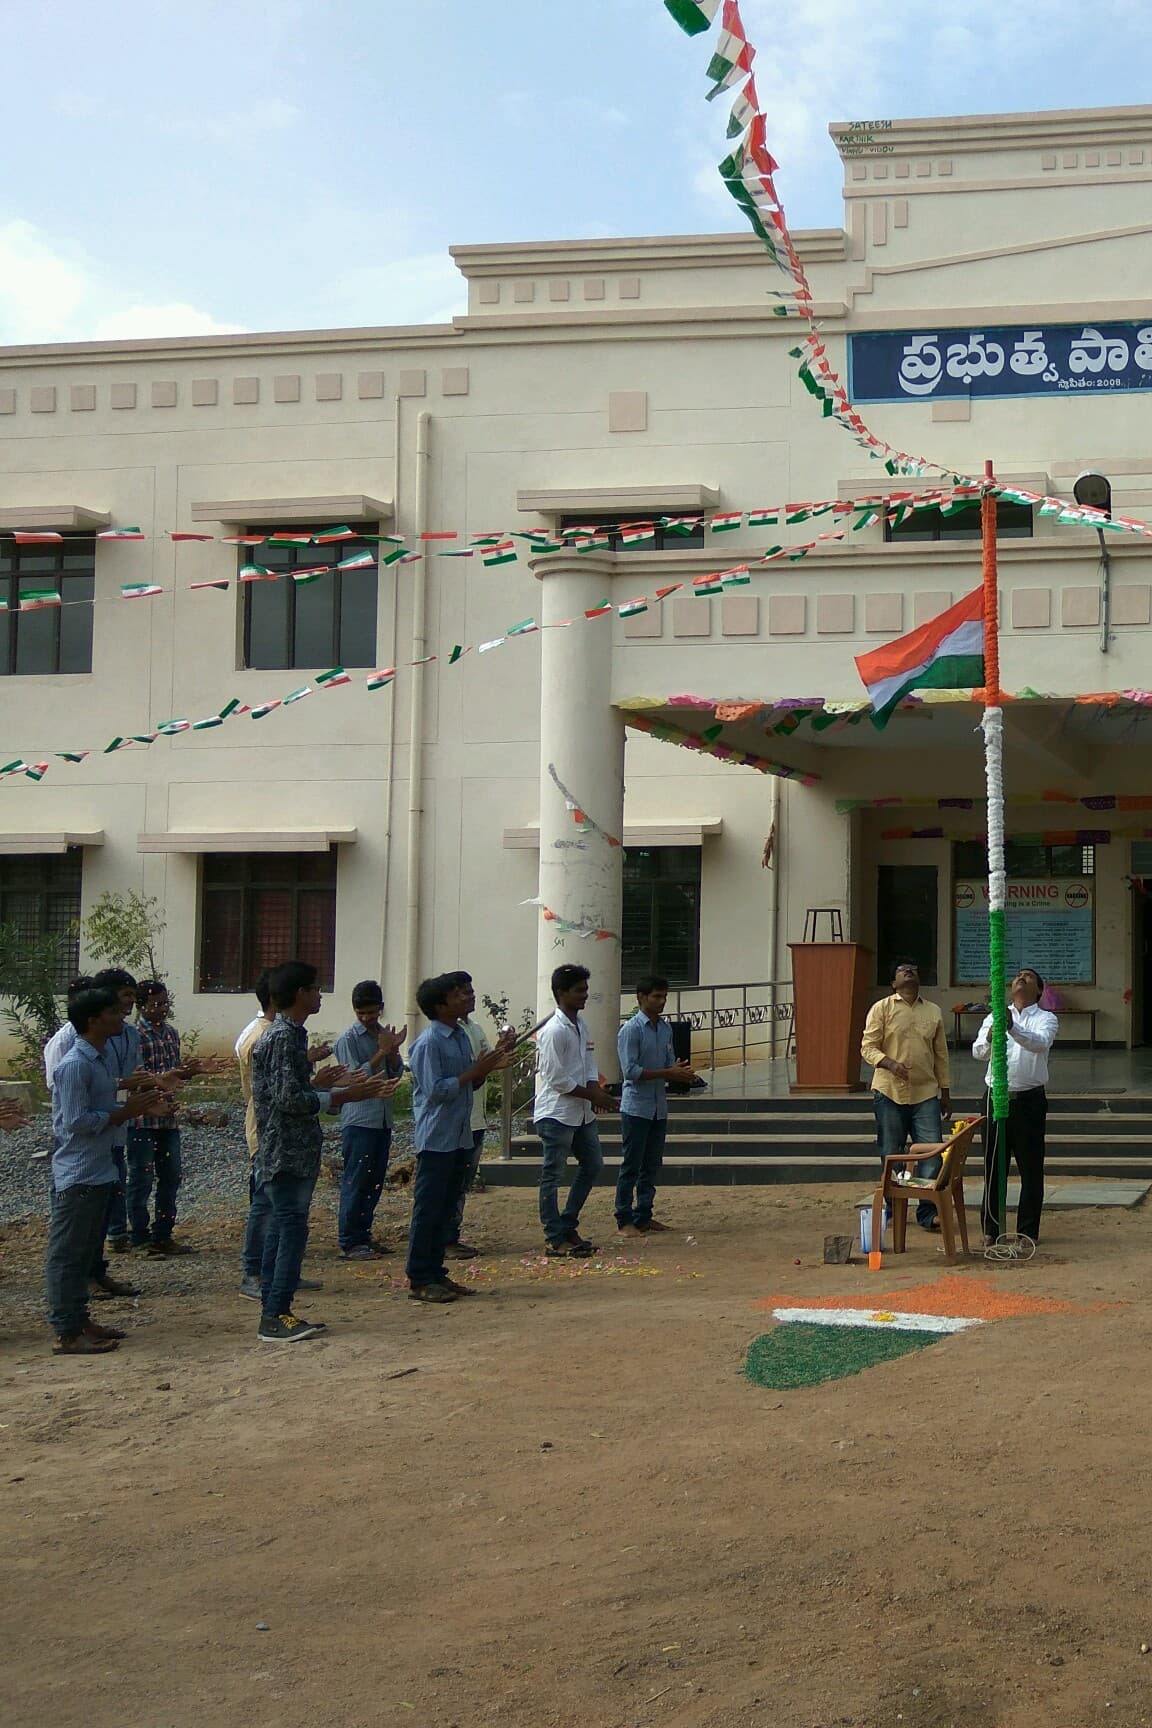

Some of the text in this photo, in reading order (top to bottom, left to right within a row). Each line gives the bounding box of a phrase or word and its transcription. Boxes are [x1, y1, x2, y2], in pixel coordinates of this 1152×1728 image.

[848, 120, 892, 131] SATEESH
[898, 331, 1059, 395] ప్రభుత్వ
[981, 885, 1059, 898] WRNING
